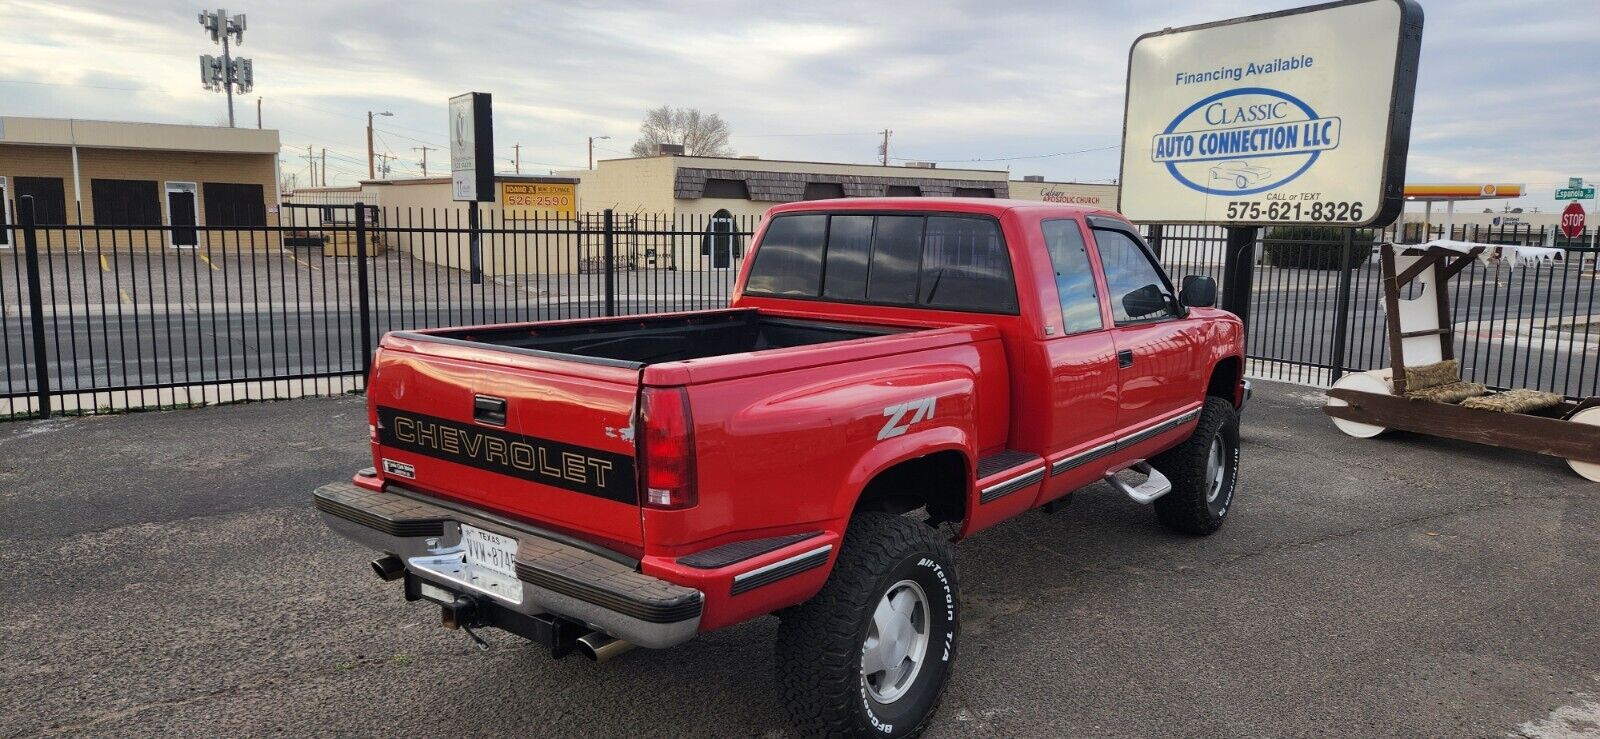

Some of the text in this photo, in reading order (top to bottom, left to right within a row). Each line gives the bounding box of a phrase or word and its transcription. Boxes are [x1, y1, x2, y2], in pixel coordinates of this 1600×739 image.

[1175, 55, 1313, 86] Financing Available
[1155, 120, 1332, 158] AUTO CONNECTION LLC
[1043, 196, 1075, 204] APOSTOLIC
[1266, 193, 1287, 201] CALL
[1300, 192, 1321, 201] TEXT
[1226, 201, 1363, 222] 575-621-8326
[1562, 214, 1584, 226] STOP
[876, 396, 937, 441] Z71
[394, 416, 612, 488] CHEVROLET
[478, 532, 500, 545] TEXAS
[917, 557, 953, 662] All-Terrain T/A
